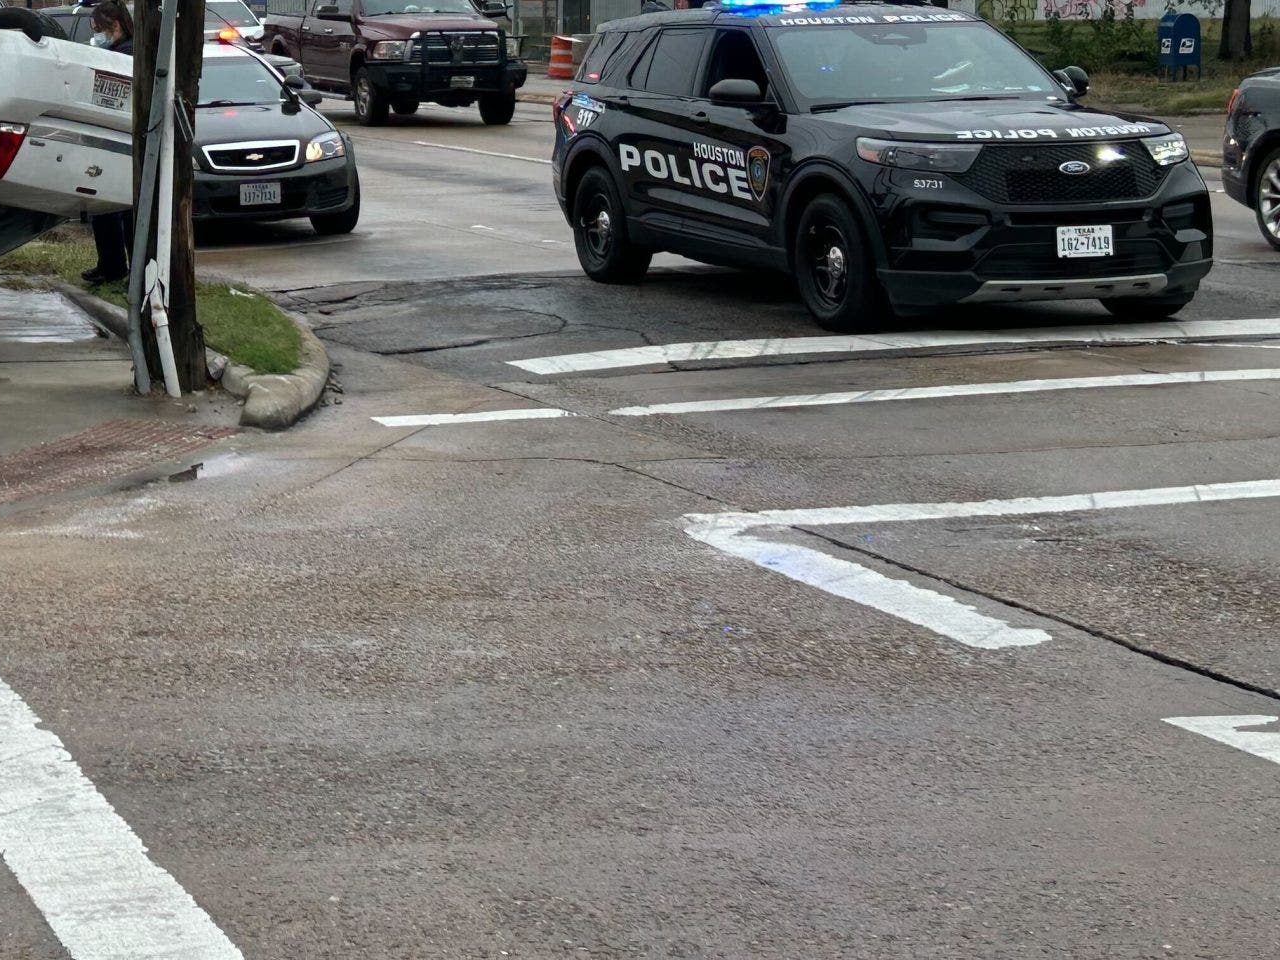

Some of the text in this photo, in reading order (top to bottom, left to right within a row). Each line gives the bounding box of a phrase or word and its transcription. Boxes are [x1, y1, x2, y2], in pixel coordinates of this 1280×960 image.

[780, 13, 966, 26] HOUSTON POLICE
[576, 109, 594, 127] 911
[693, 141, 746, 168] HOUSTON
[619, 143, 754, 201] POLICE
